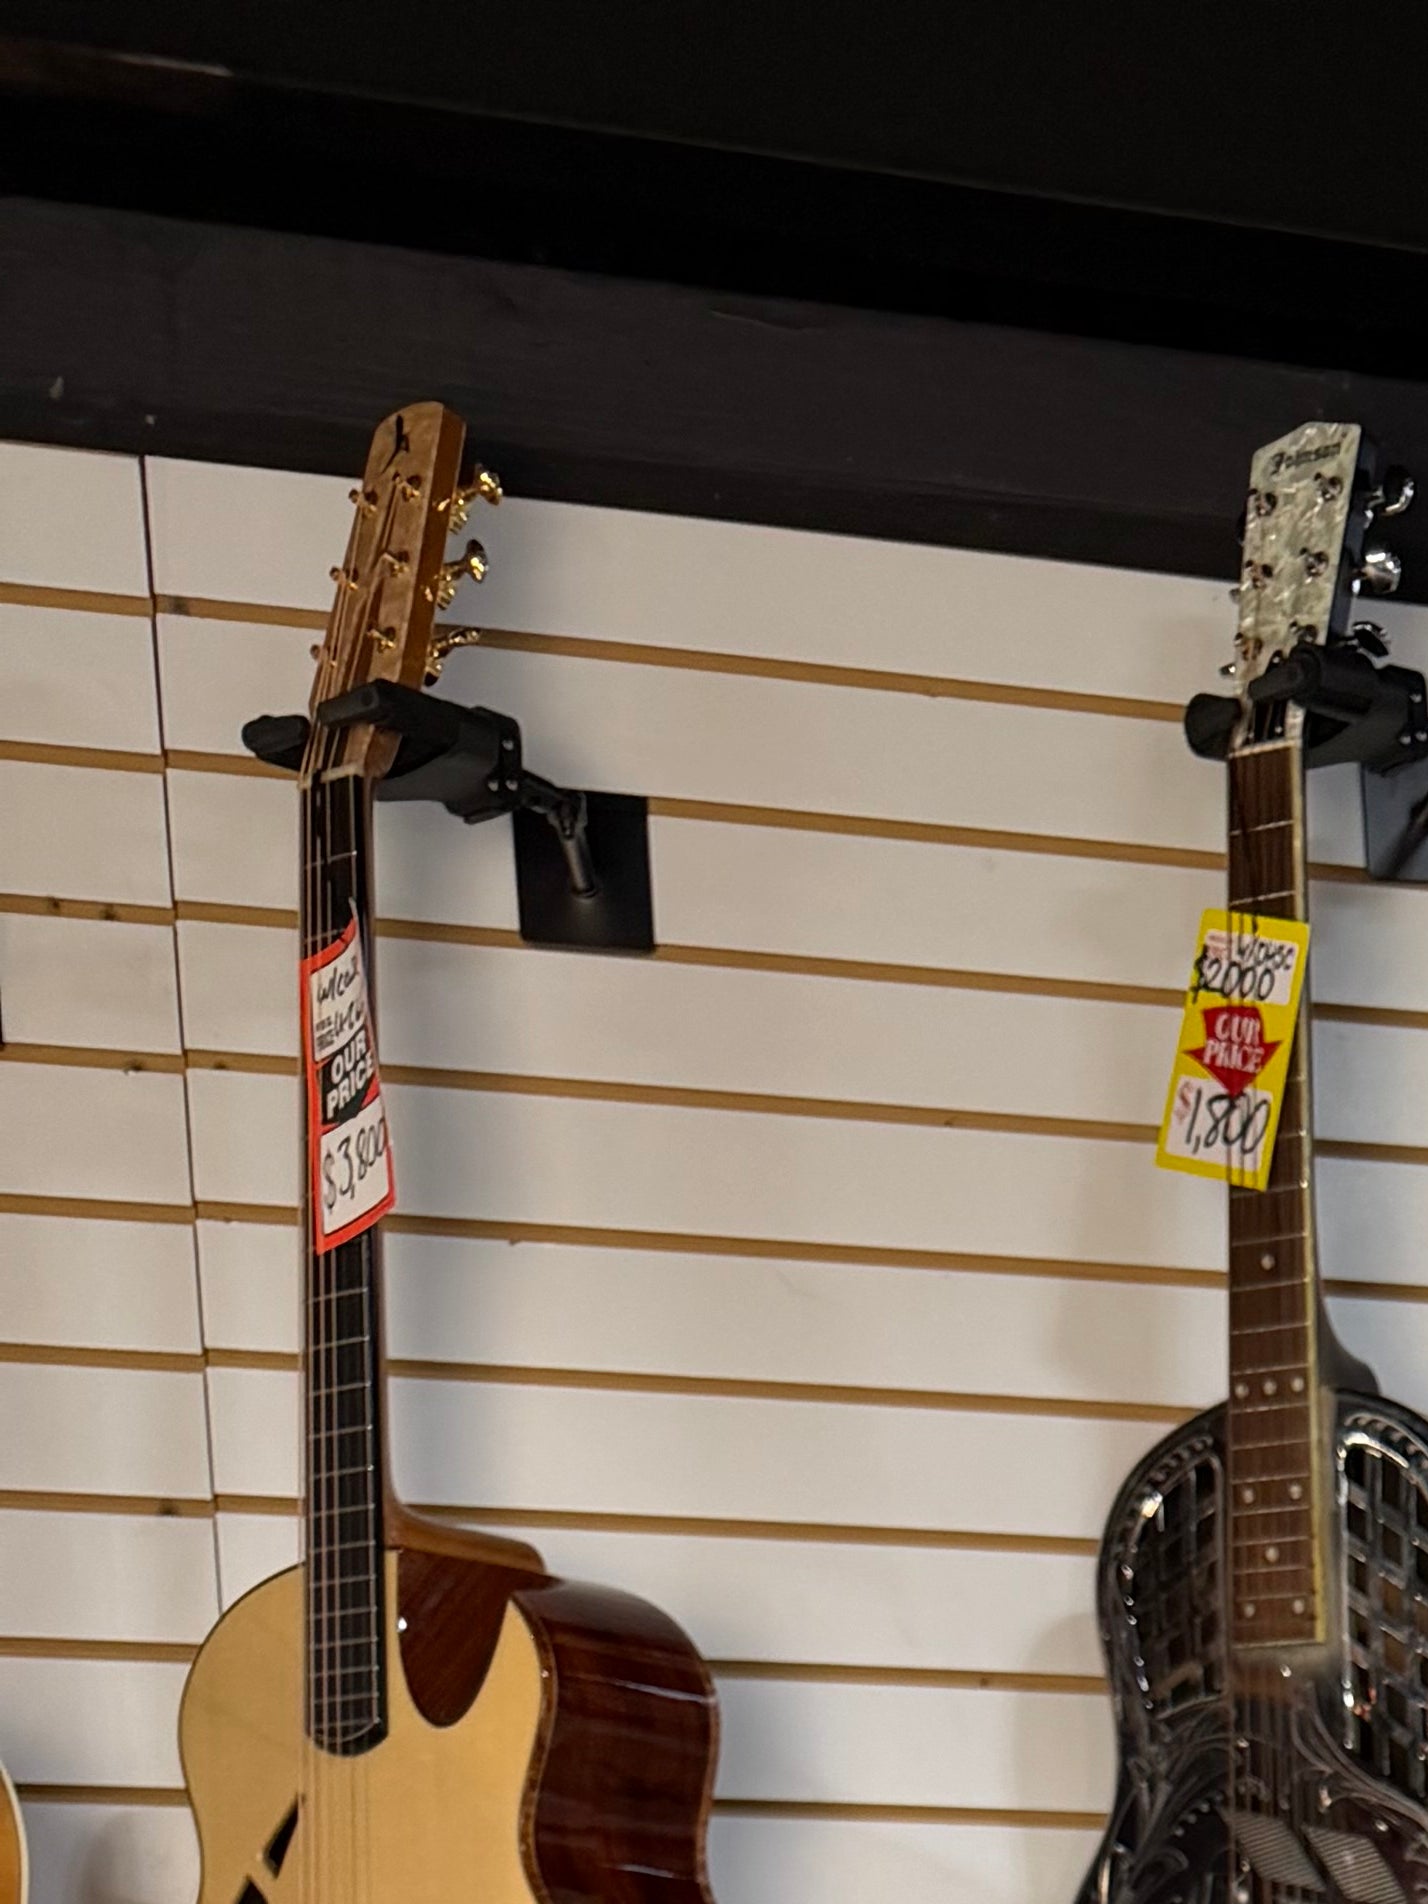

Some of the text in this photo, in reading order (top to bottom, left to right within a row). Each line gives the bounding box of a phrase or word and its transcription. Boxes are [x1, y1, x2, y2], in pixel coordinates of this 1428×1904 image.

[330, 1026, 366, 1086] OUR
[1203, 1038, 1264, 1074] PRICE
[1214, 1012, 1262, 1042] OUR
[326, 1048, 375, 1119] PRICE
[322, 1118, 387, 1215] $3,800
